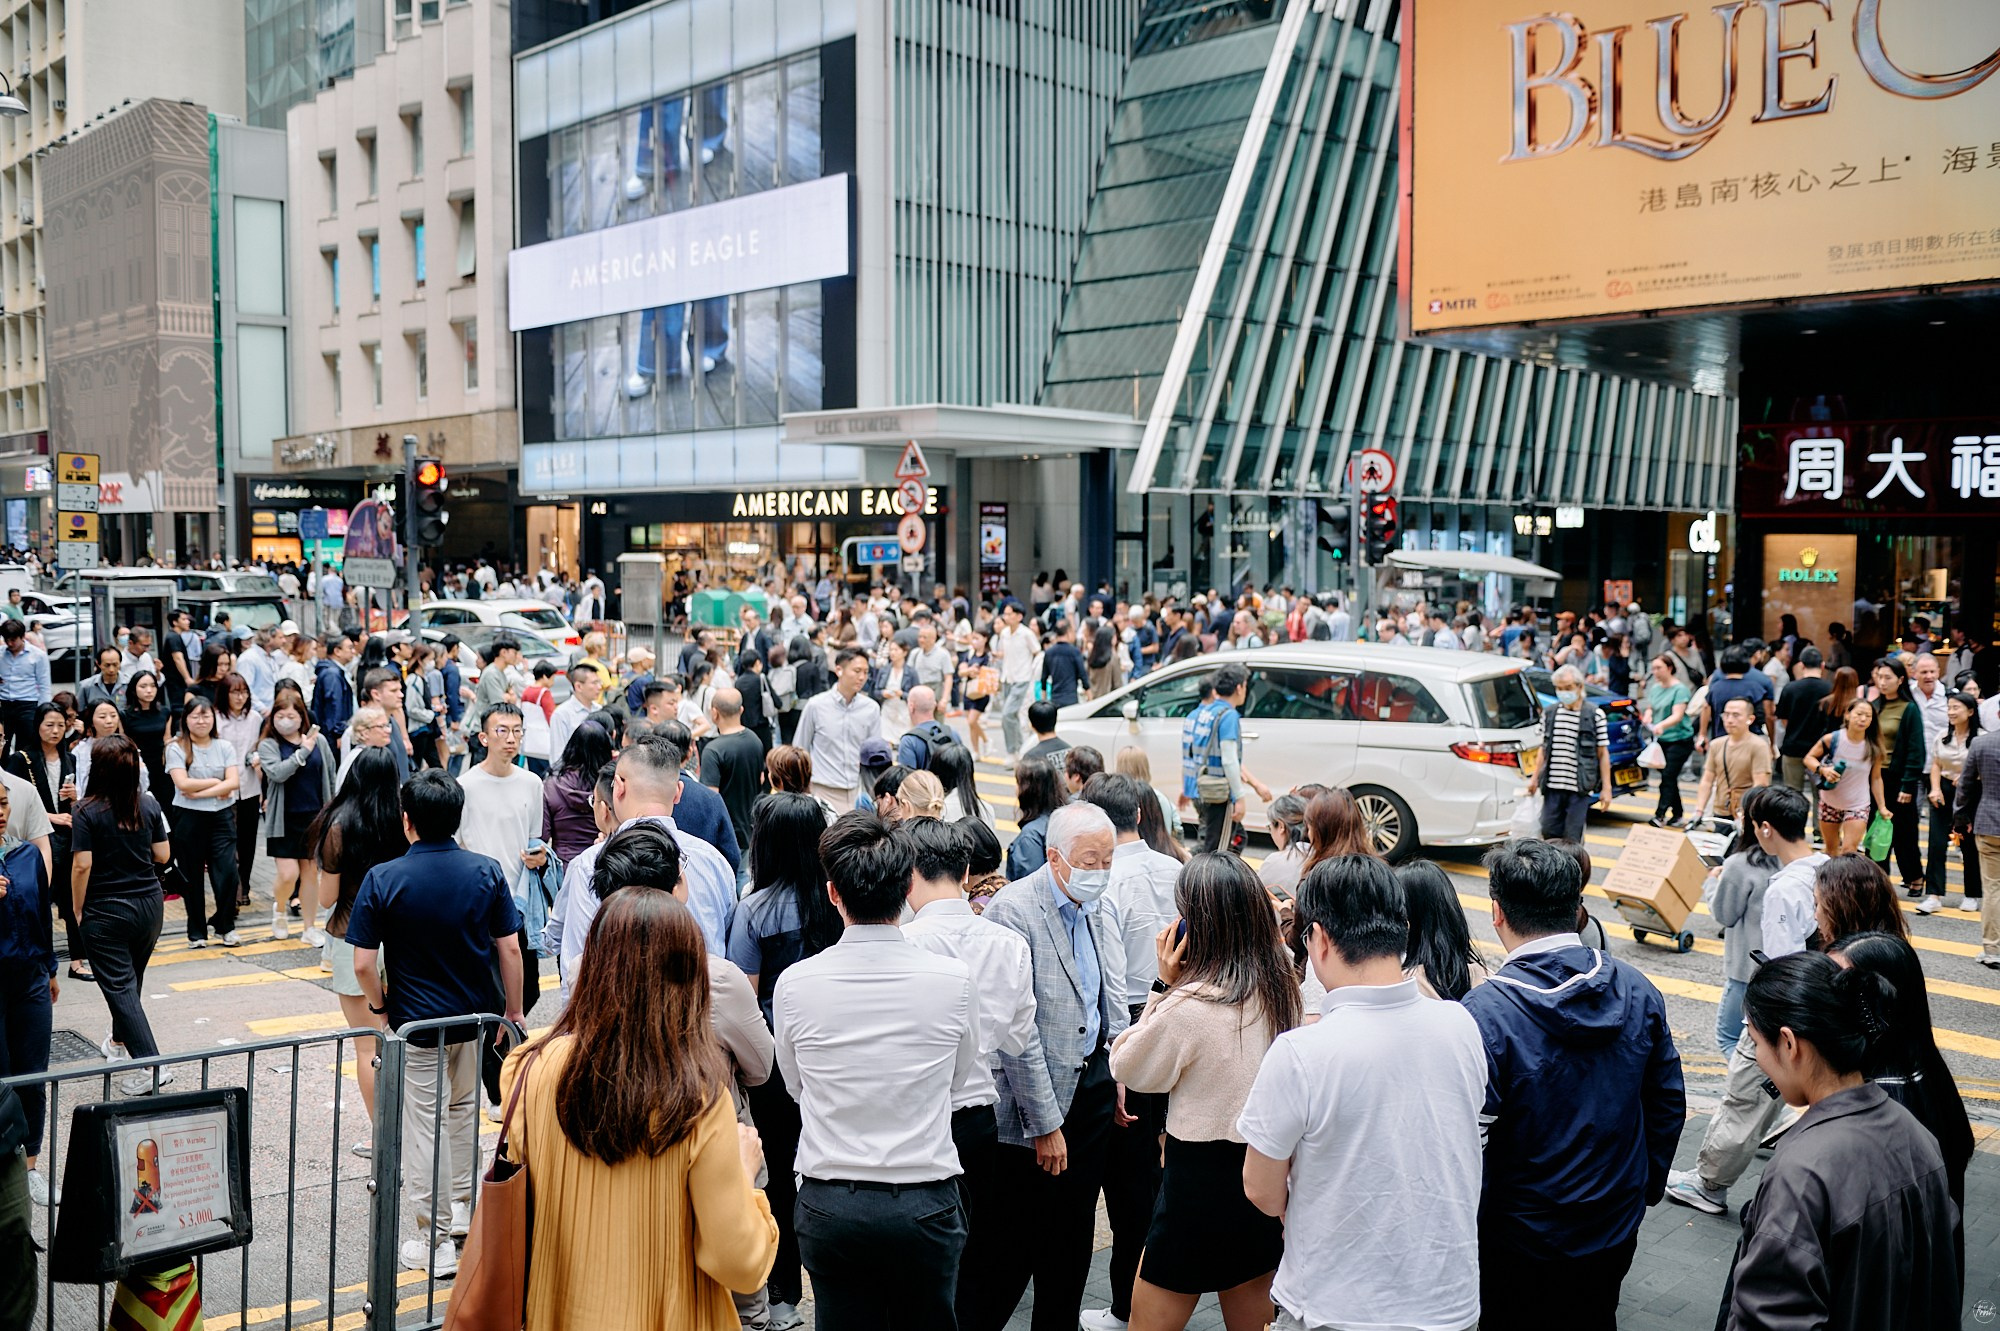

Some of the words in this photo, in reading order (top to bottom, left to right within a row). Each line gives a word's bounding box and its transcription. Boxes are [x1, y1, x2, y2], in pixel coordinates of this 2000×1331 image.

[1499, 0, 1841, 163] BLUE
[570, 247, 676, 290] AMERICAN
[689, 230, 760, 267] EAGLE
[1446, 298, 1477, 311] MTR
[1784, 436, 2000, 500] 周大福
[84, 486, 91, 495] 7
[84, 501, 95, 510] 12
[591, 502, 607, 515] AE
[732, 490, 849, 517] AMERICAN
[84, 544, 91, 553] 7
[84, 558, 91, 567] 7
[1779, 568, 1839, 583] ROLEX
[186, 1136, 207, 1146] Warning
